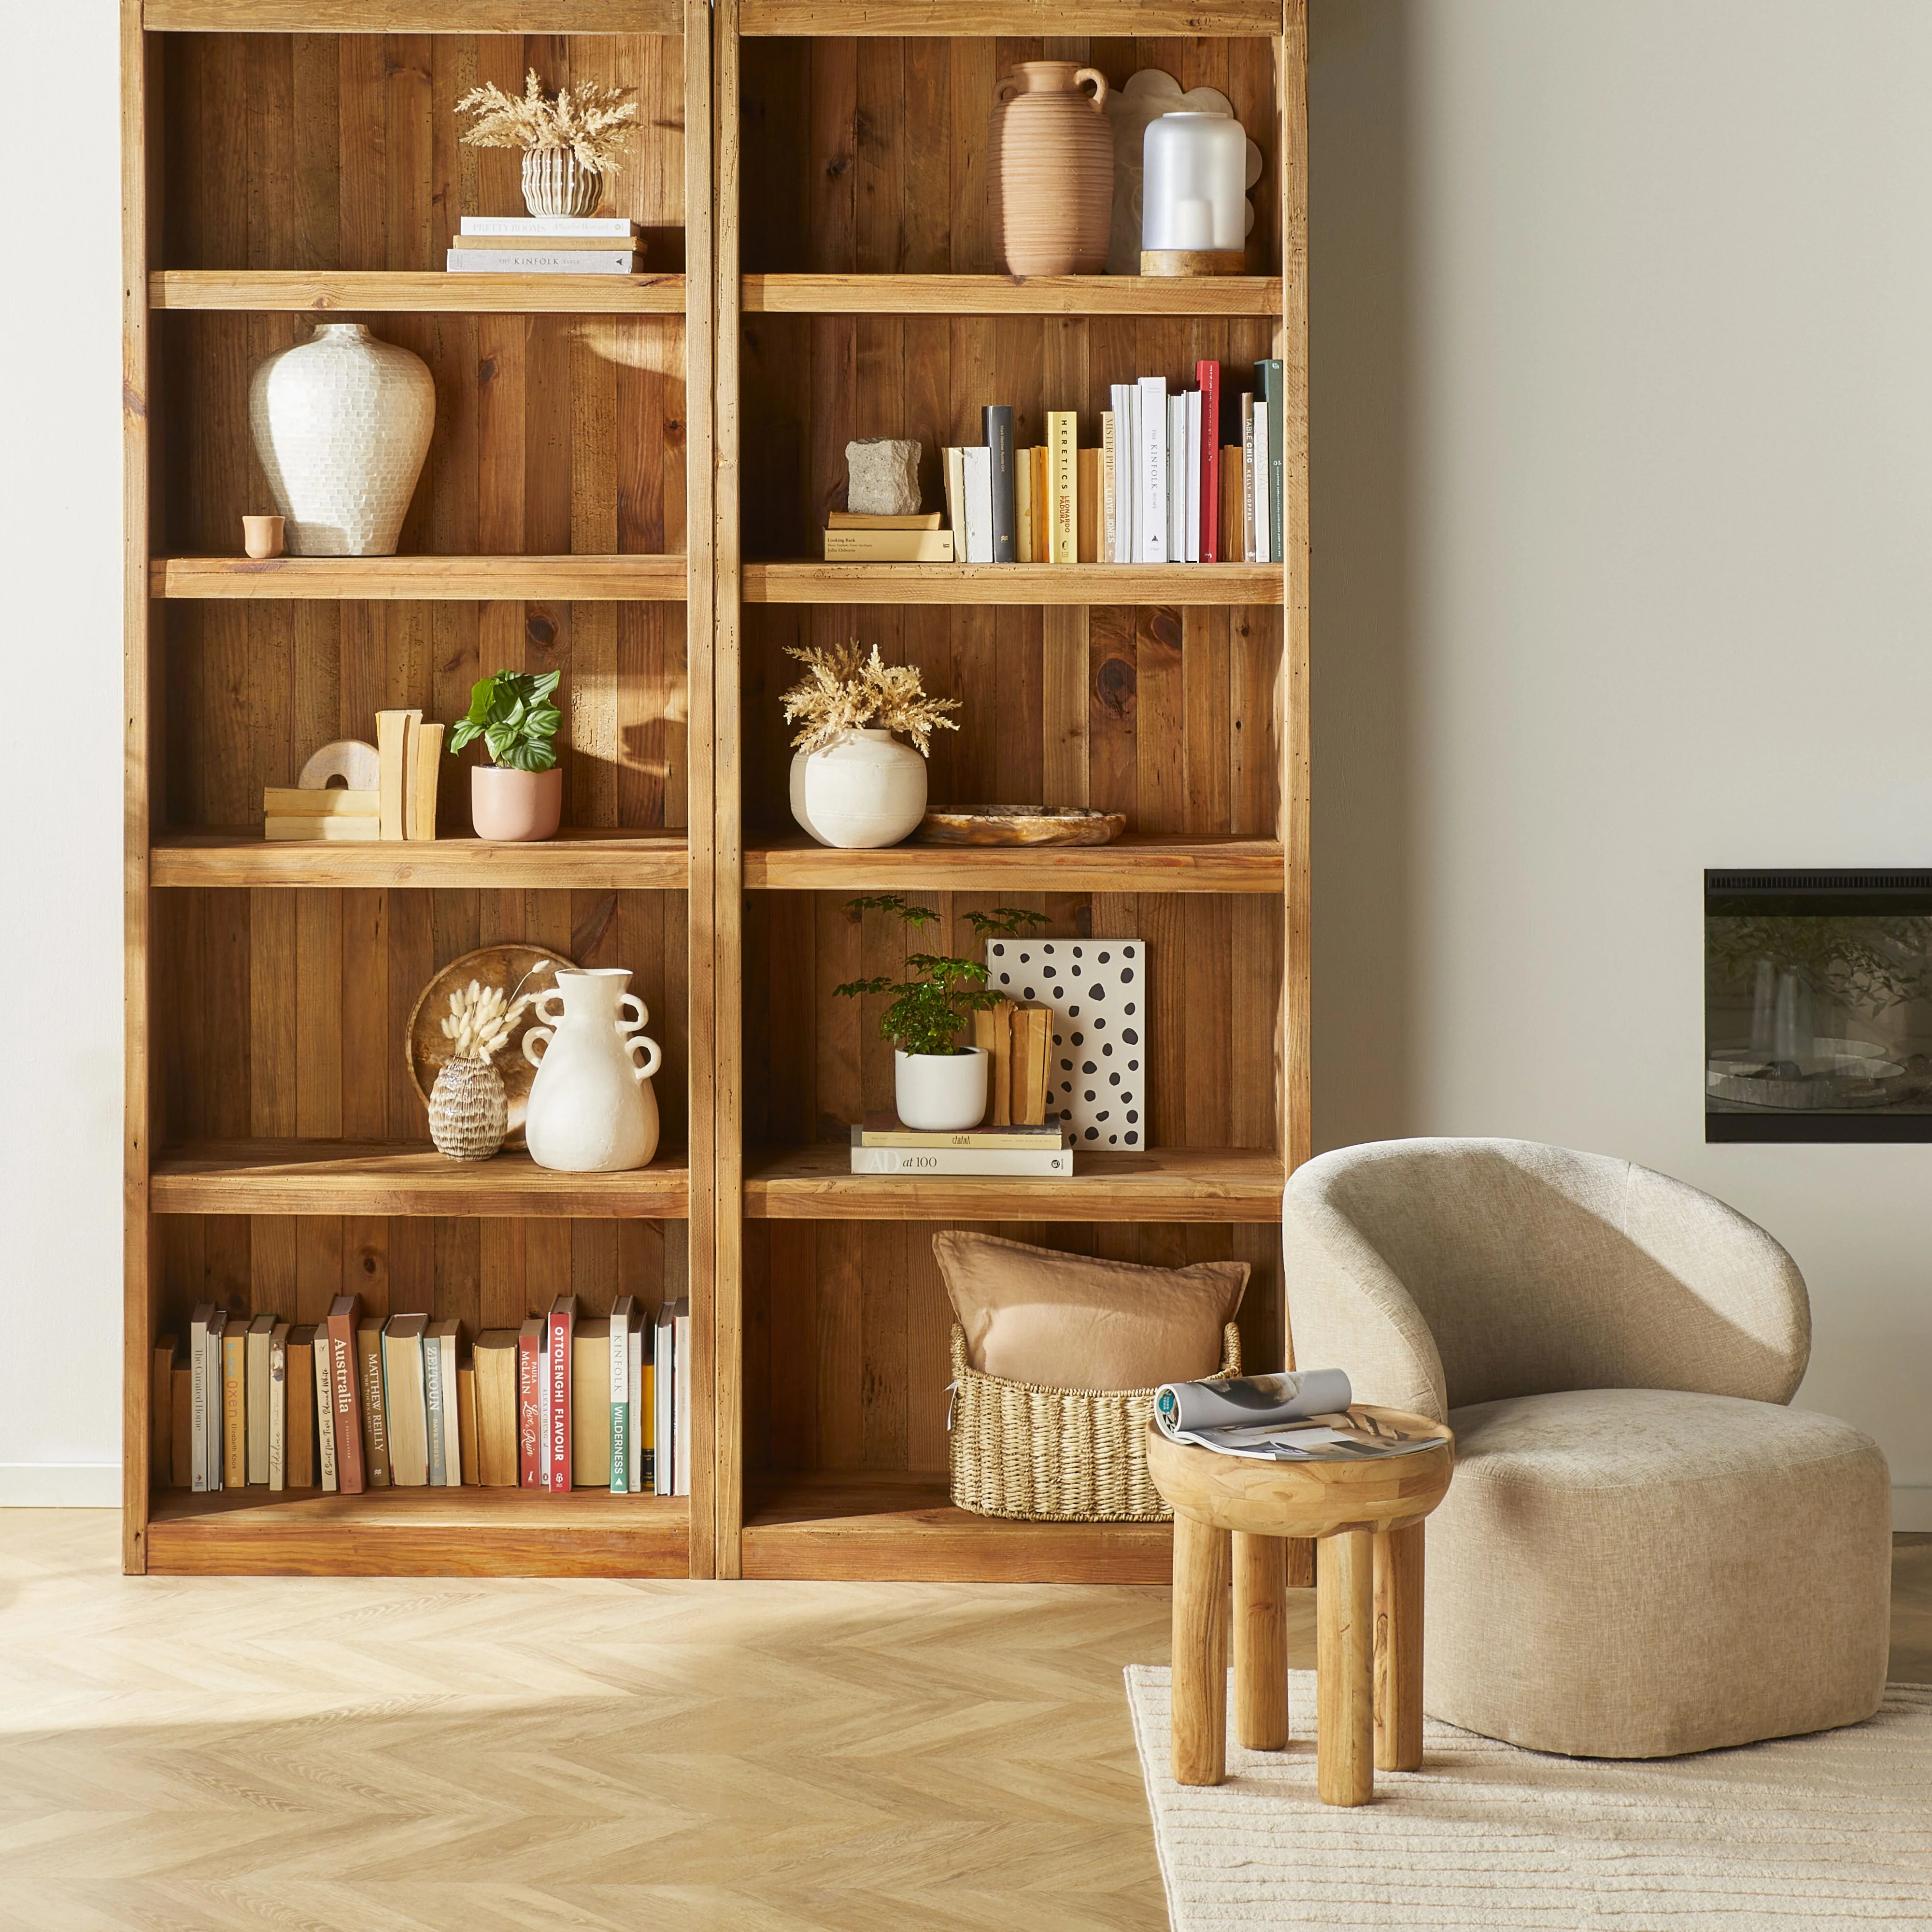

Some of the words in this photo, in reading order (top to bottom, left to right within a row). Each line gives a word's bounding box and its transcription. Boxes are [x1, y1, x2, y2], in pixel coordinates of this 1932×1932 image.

[473, 224, 508, 232] PRETTY
[512, 224, 546, 232] ROOMS
[1105, 488, 1113, 513] LLOYD
[1107, 516, 1115, 543] JONES
[952, 1136, 971, 1145] CABANA
[868, 1150, 900, 1173] AD
[903, 1157, 914, 1167] at
[916, 1156, 937, 1167] 100
[195, 1348, 203, 1364] The
[226, 1343, 235, 1378] BLACK
[521, 1351, 531, 1393] McLAIN
[555, 1326, 564, 1402] OTTOLENGHI
[614, 1335, 622, 1392] KINFOLK
[195, 1366, 203, 1403] Curated
[321, 1368, 329, 1387] White
[334, 1338, 352, 1413] Australia
[369, 1354, 381, 1411] MATTHEW
[427, 1347, 440, 1411] ZEITOUN
[628, 1364, 640, 1396] Plants
[227, 1381, 238, 1418] Oxen
[322, 1389, 330, 1415] Edmund
[523, 1401, 539, 1424] Love
[195, 1406, 203, 1431] Home
[373, 1415, 384, 1452] REILLY
[555, 1408, 564, 1461] FLAVOUR
[270, 1431, 282, 1474] Adeline
[325, 1437, 333, 1450] from
[521, 1429, 536, 1457] Ruin
[614, 1406, 623, 1474] WILDERNESS
